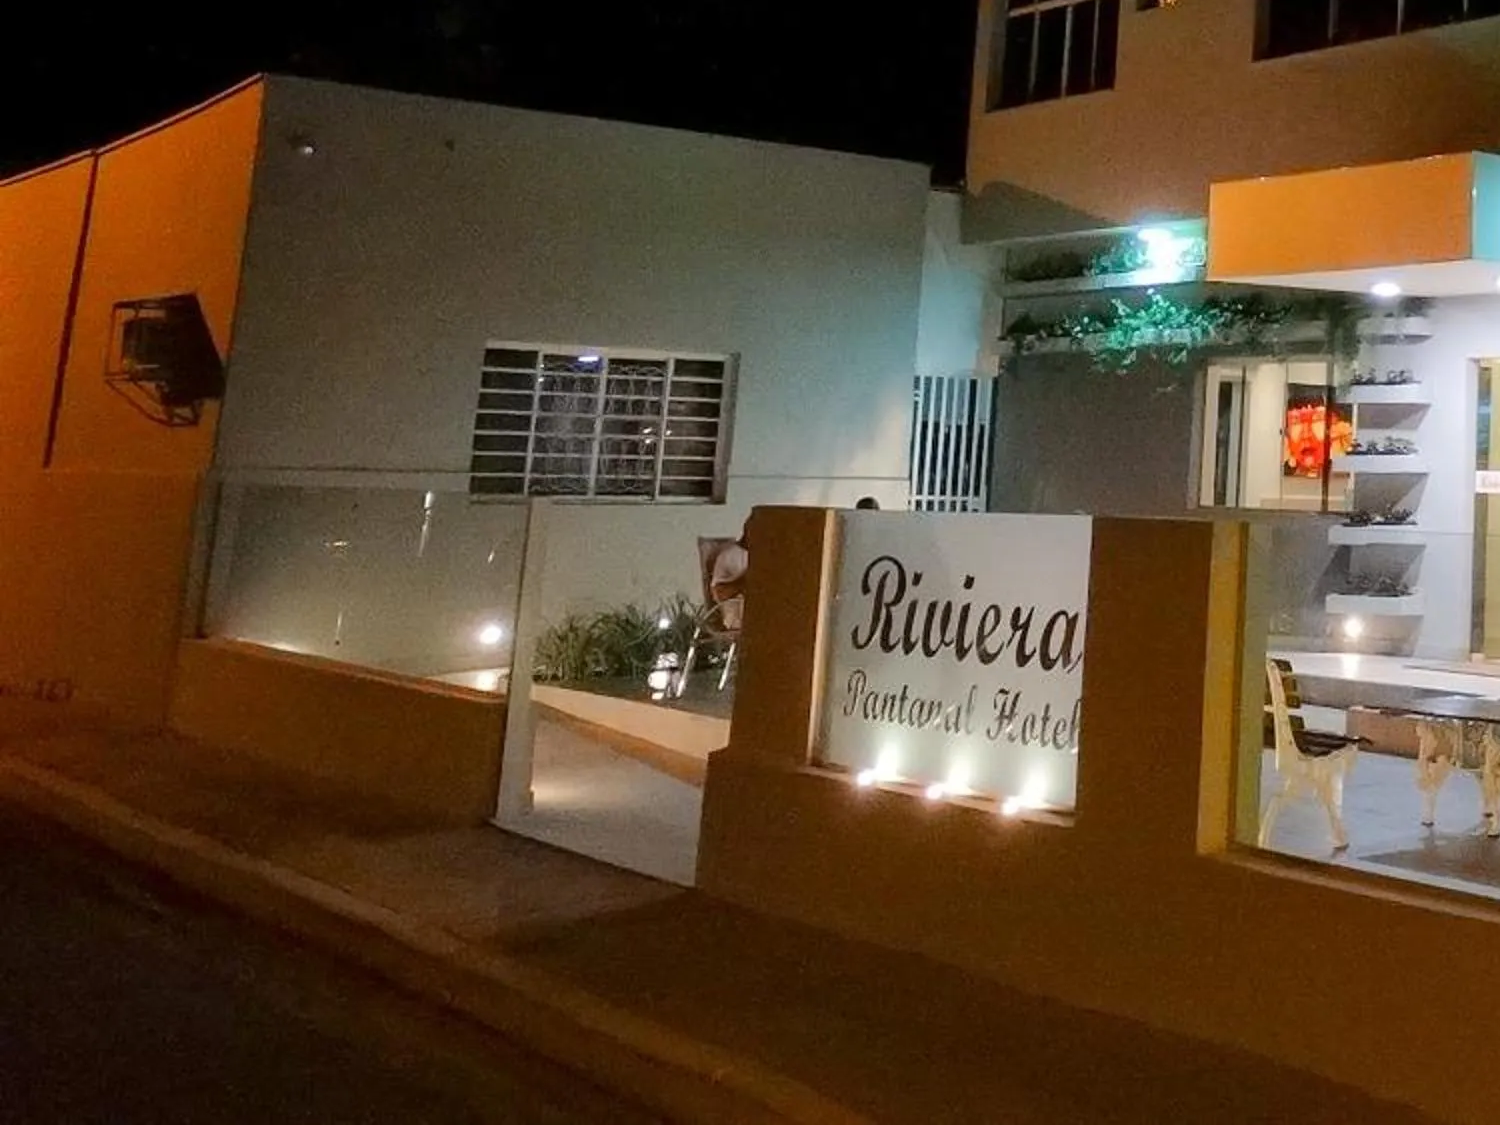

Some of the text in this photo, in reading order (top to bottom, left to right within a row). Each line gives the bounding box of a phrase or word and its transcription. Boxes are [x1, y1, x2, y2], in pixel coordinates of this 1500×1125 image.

[850, 554, 1083, 674] Riviera
[843, 668, 1082, 751] Pantanal Hotel
